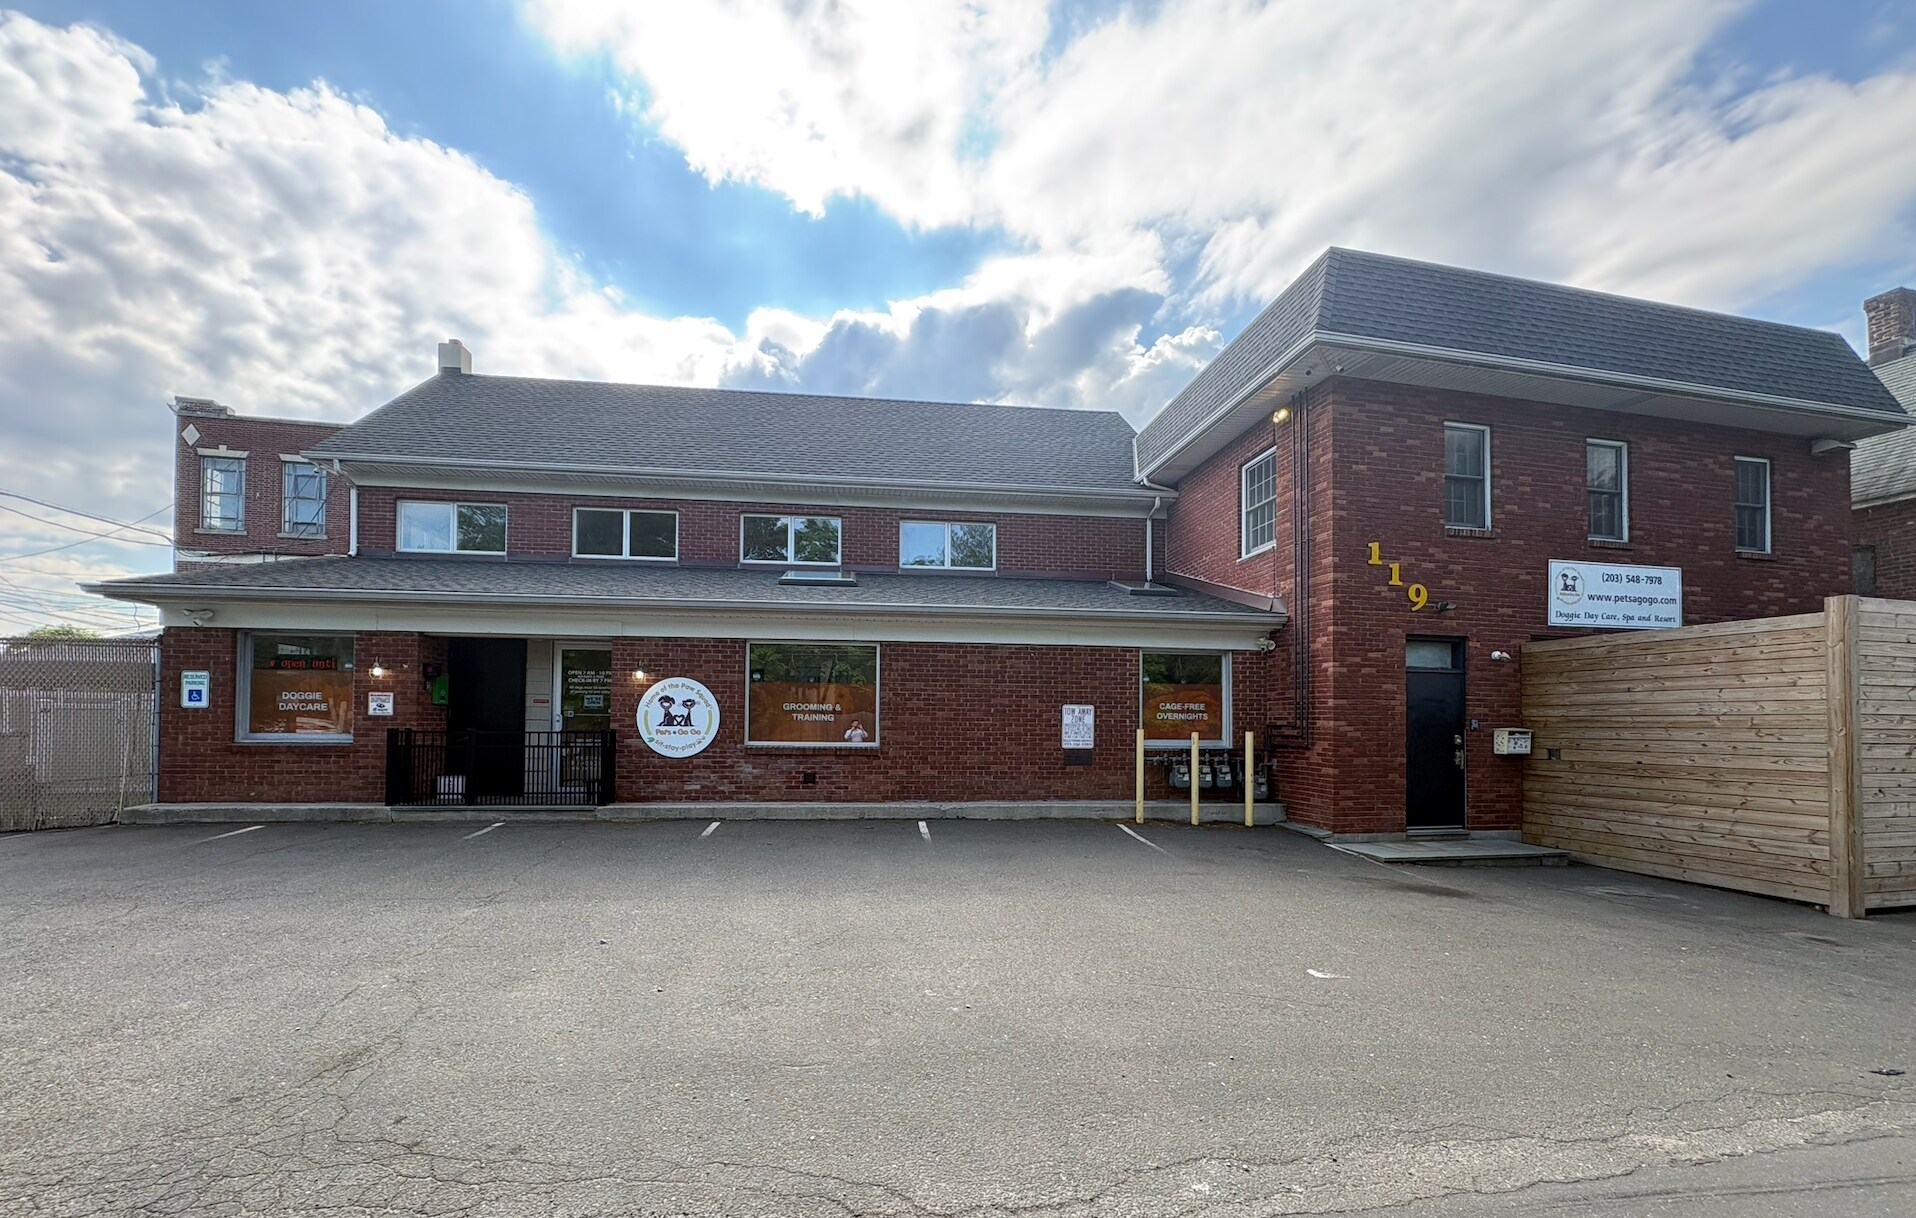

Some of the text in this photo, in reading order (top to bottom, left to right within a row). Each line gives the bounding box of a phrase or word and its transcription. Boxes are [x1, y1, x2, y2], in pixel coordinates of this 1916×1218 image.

[1367, 541, 1429, 612] 119
[1601, 571, 1663, 586] (203) 548-7978
[1587, 593, 1677, 606] www.petsagogo.com
[1555, 610, 1676, 624] Doggie Day Care, Spa and Resort
[281, 659, 306, 669] open
[282, 691, 323, 700] DOGGIE
[644, 690, 660, 709] Home
[660, 685, 667, 693] of
[681, 682, 696, 692] Paw
[695, 689, 712, 708] Squad
[278, 702, 328, 711] DAYCARE
[782, 702, 842, 711] GROOMING &
[1159, 702, 1206, 711] CAGE-FREE
[1064, 707, 1093, 716] TOW AWAY
[1156, 712, 1209, 720] OVERNIGHTS
[791, 713, 835, 722] TRAINING
[1071, 715, 1086, 724] ZONE
[677, 728, 689, 736] Go
[690, 728, 702, 736] Go
